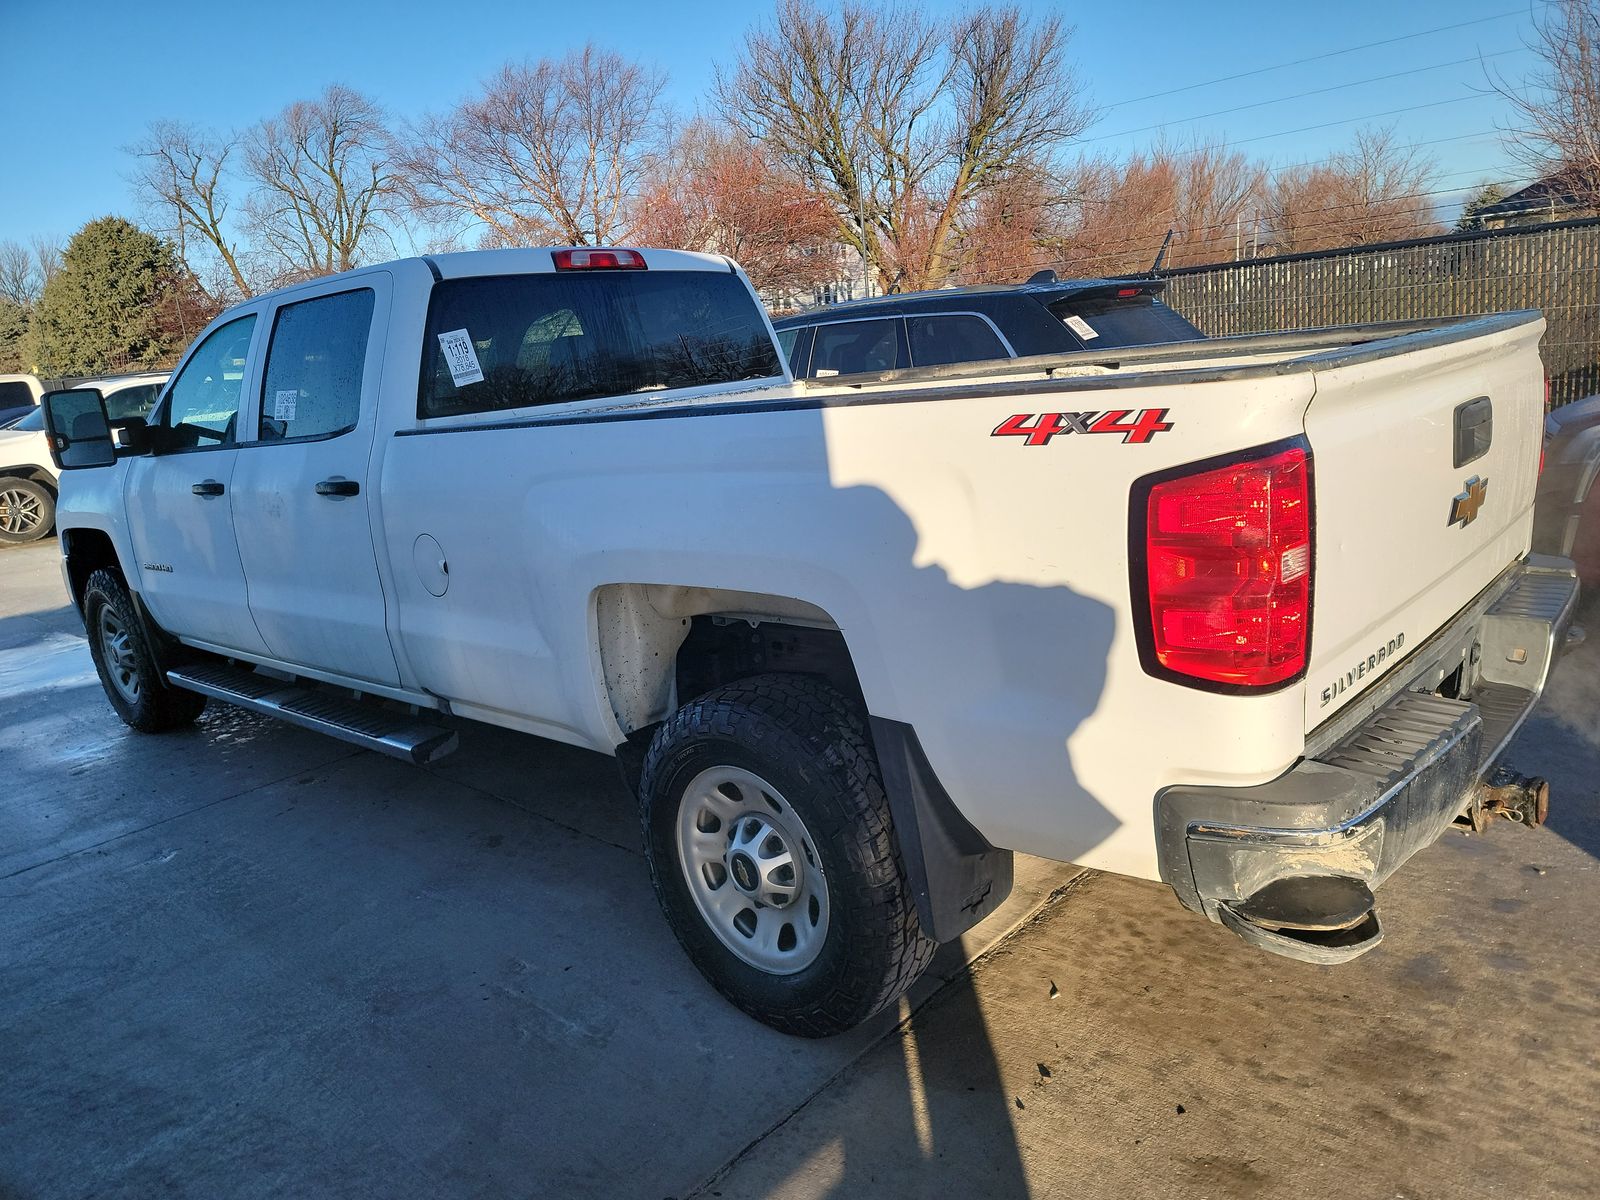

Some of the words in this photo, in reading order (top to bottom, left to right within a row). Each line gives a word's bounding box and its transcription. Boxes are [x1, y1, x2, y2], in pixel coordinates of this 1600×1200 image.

[448, 341, 469, 357] 1:119
[456, 354, 470, 364] 2018
[1320, 632, 1405, 708] SILVERADO
